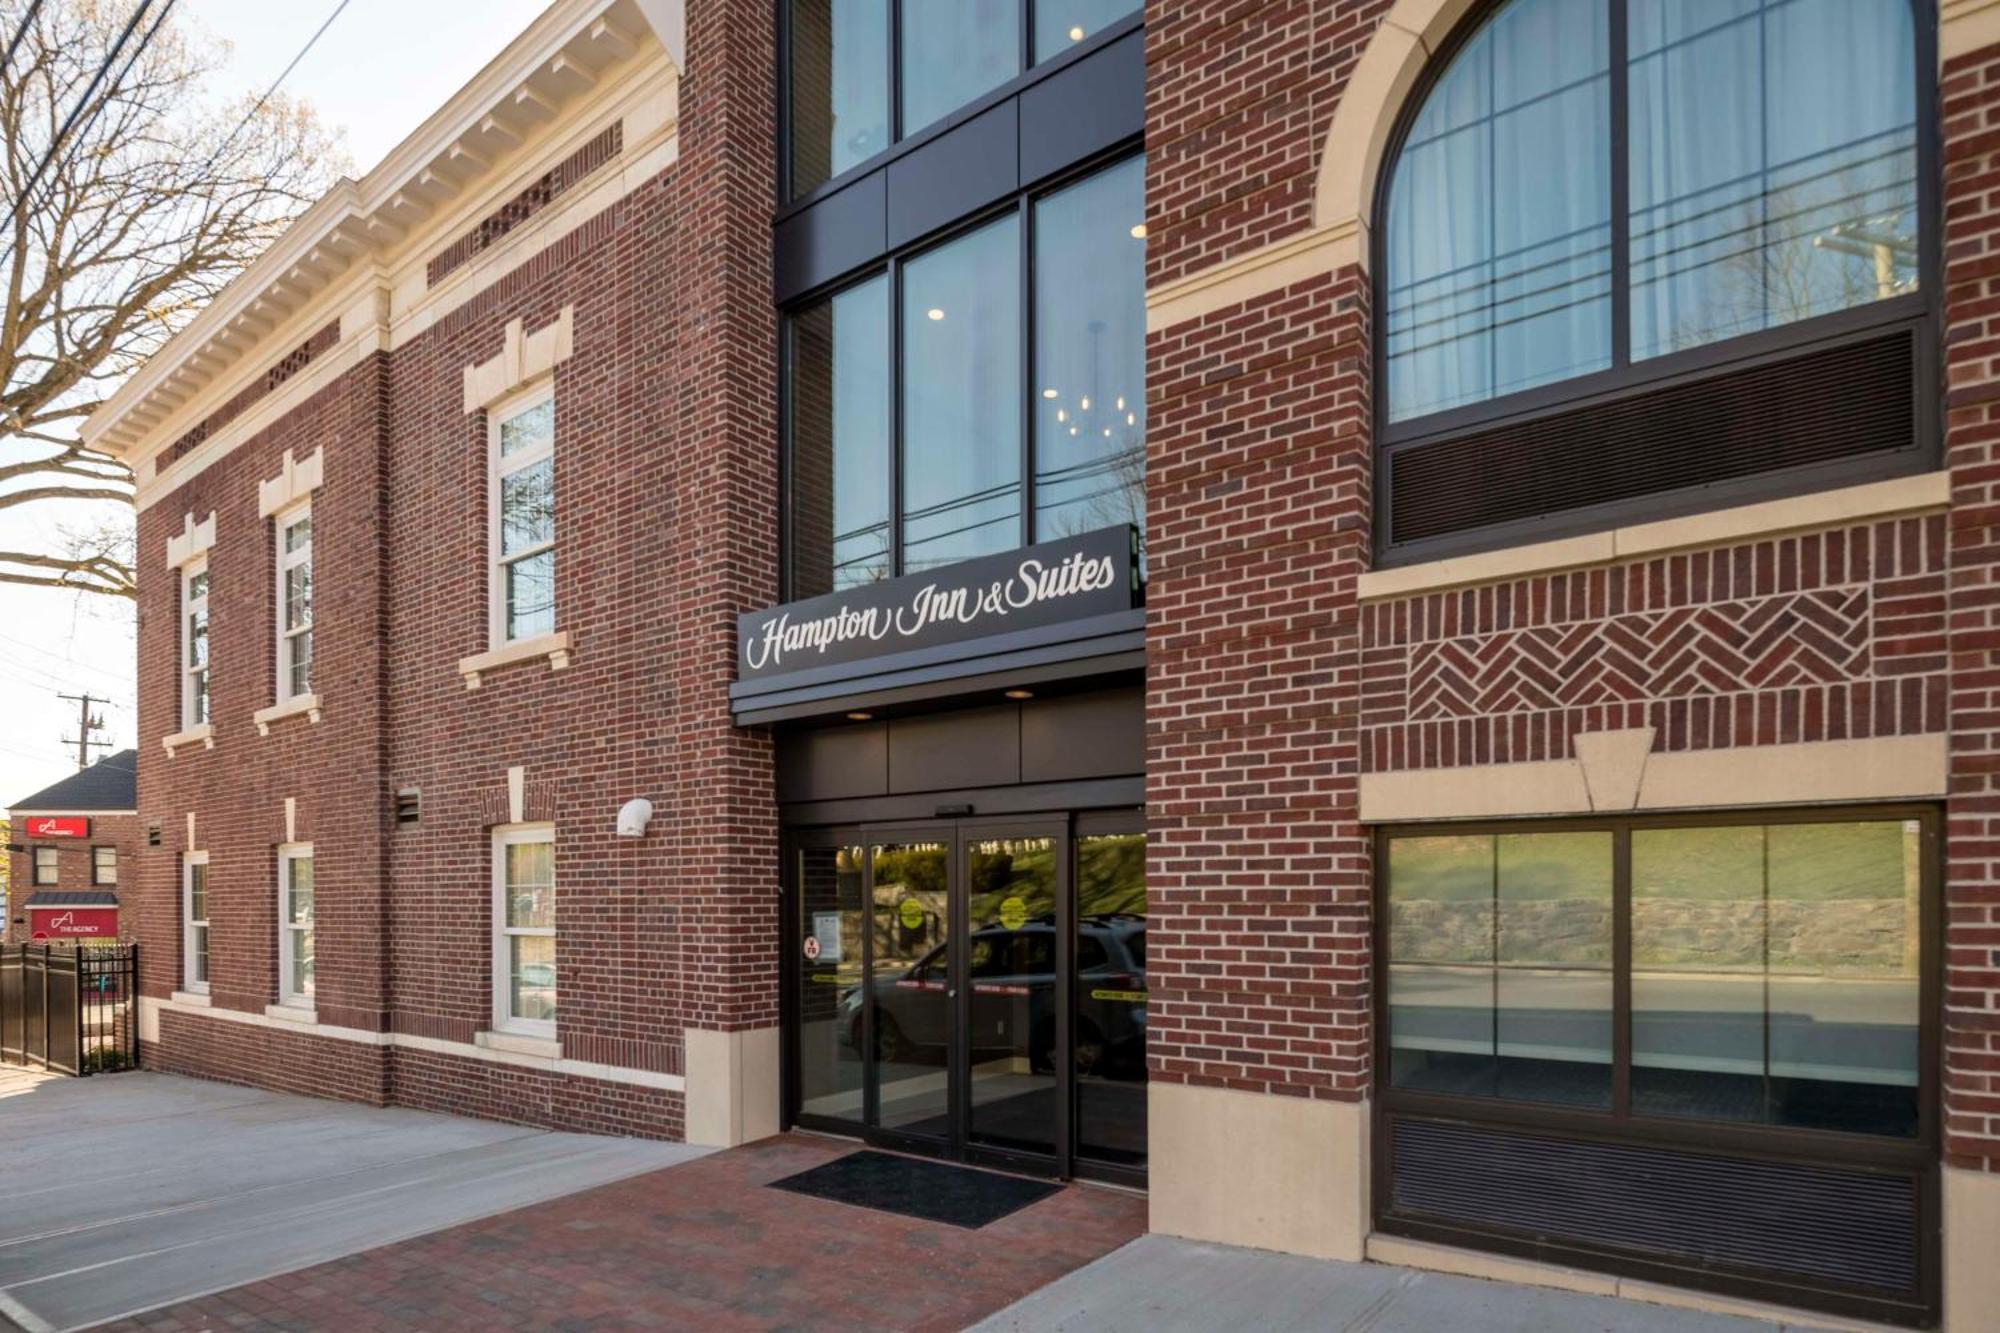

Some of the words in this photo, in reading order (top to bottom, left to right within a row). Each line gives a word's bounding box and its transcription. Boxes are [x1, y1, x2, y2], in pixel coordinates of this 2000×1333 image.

[746, 604, 892, 670] Hampton
[896, 583, 984, 636] Inn
[983, 582, 1008, 616] &
[1005, 551, 1115, 609] Suites
